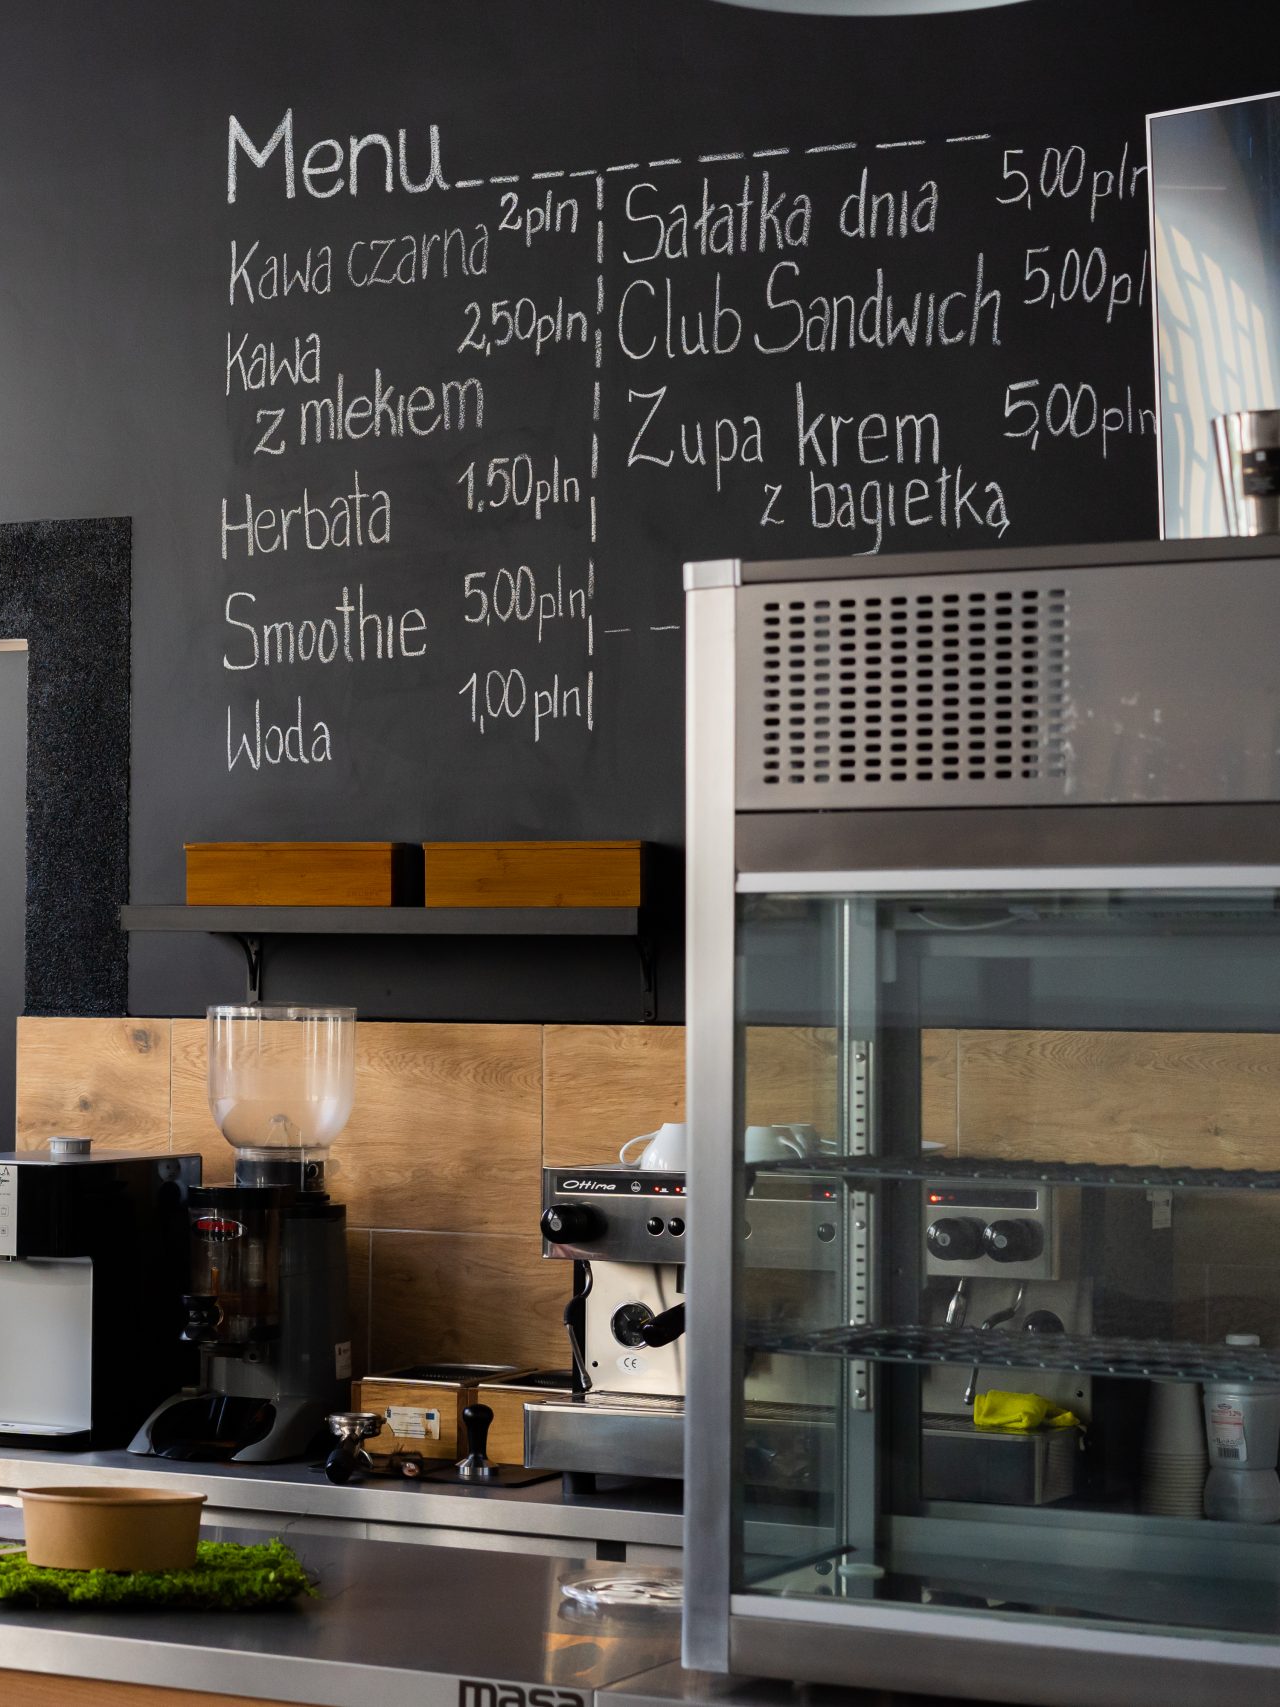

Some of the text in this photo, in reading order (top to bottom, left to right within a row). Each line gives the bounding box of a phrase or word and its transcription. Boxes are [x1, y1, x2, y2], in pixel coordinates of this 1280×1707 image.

[227, 108, 451, 204] Menu
[623, 167, 939, 264] Sałatka dnia
[229, 223, 489, 306] Kawa czarna
[618, 252, 1002, 360] Club Sandwich
[1023, 245, 1148, 324] 5,00pl
[225, 331, 321, 397] Kawa
[300, 367, 484, 446] mlekiem
[627, 381, 941, 493] Zupa krem
[221, 469, 392, 560] Herbata
[809, 465, 1012, 557] bagietką
[223, 583, 428, 671] Smoothie
[227, 695, 333, 772] Woda
[562, 1180, 617, 1191] Ottima
